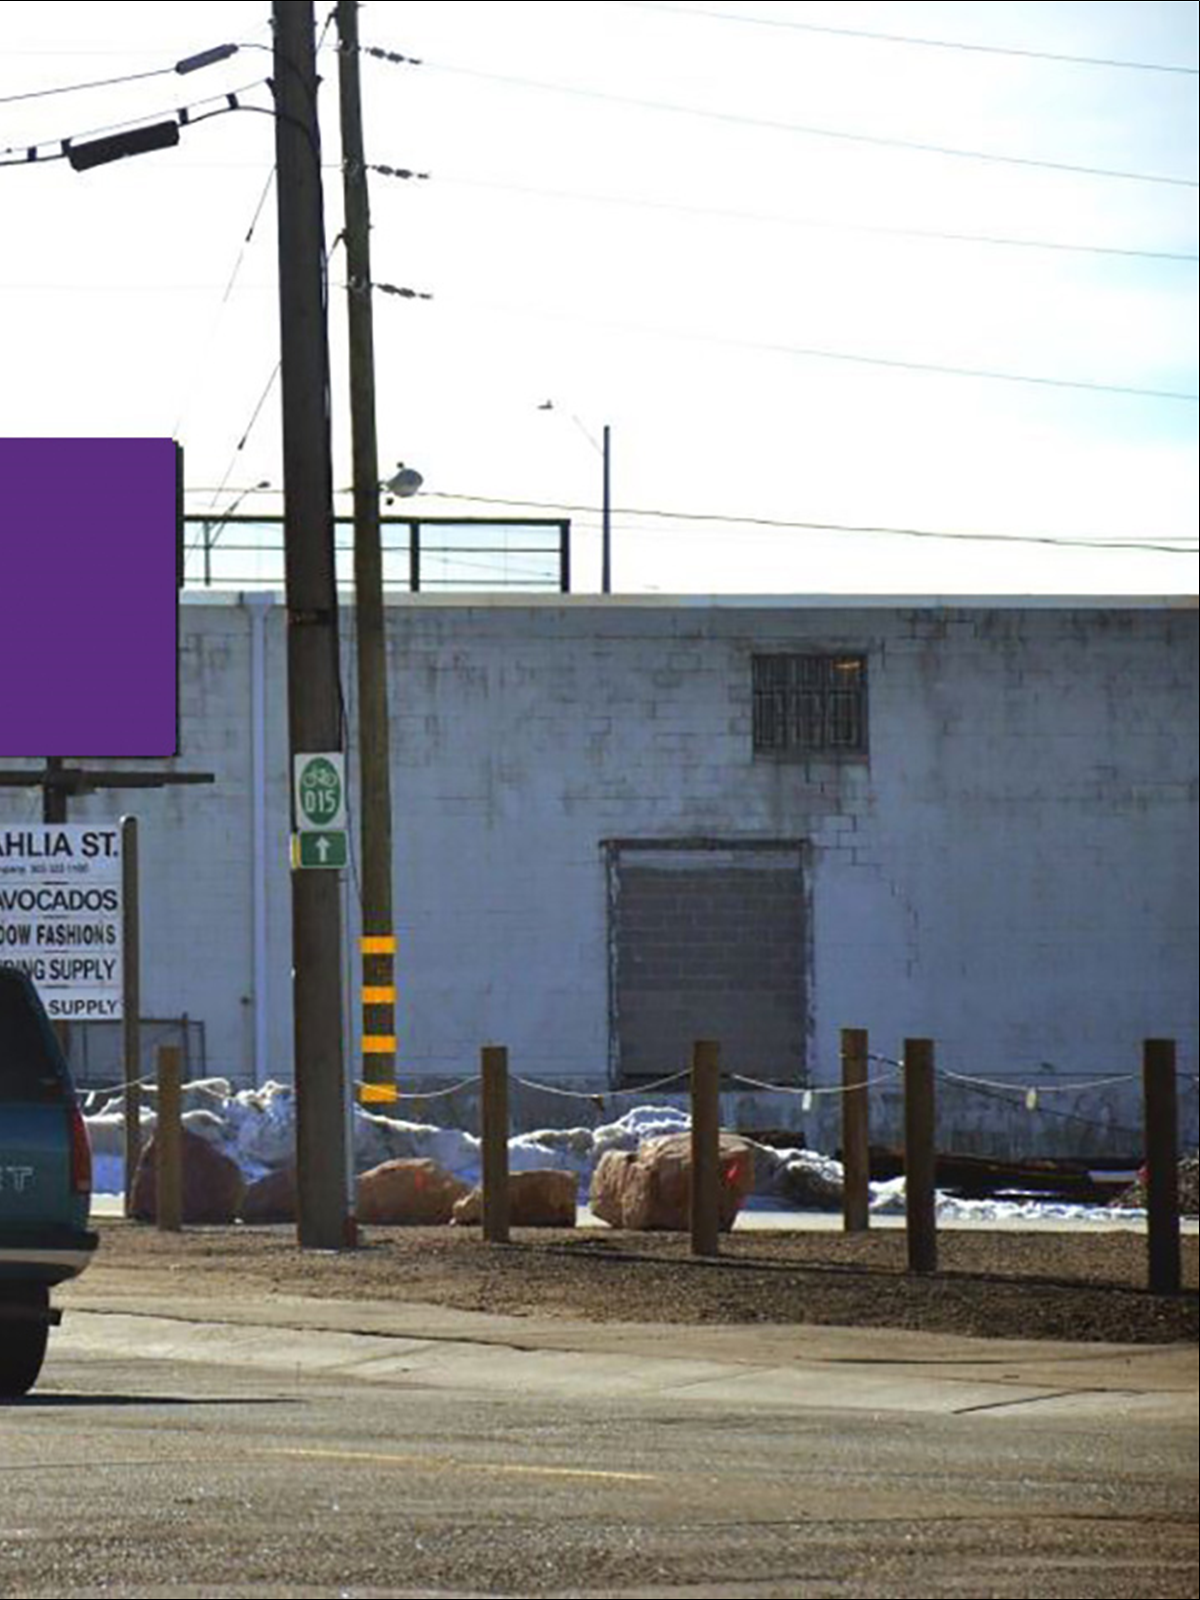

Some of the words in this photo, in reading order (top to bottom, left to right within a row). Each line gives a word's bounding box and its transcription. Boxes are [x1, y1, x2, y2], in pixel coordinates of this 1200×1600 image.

[81, 832, 119, 858] ST.
[36, 923, 116, 946] FASHIONS
[49, 958, 117, 981] SUPPLY
[48, 1000, 117, 1015] SUPPLY
